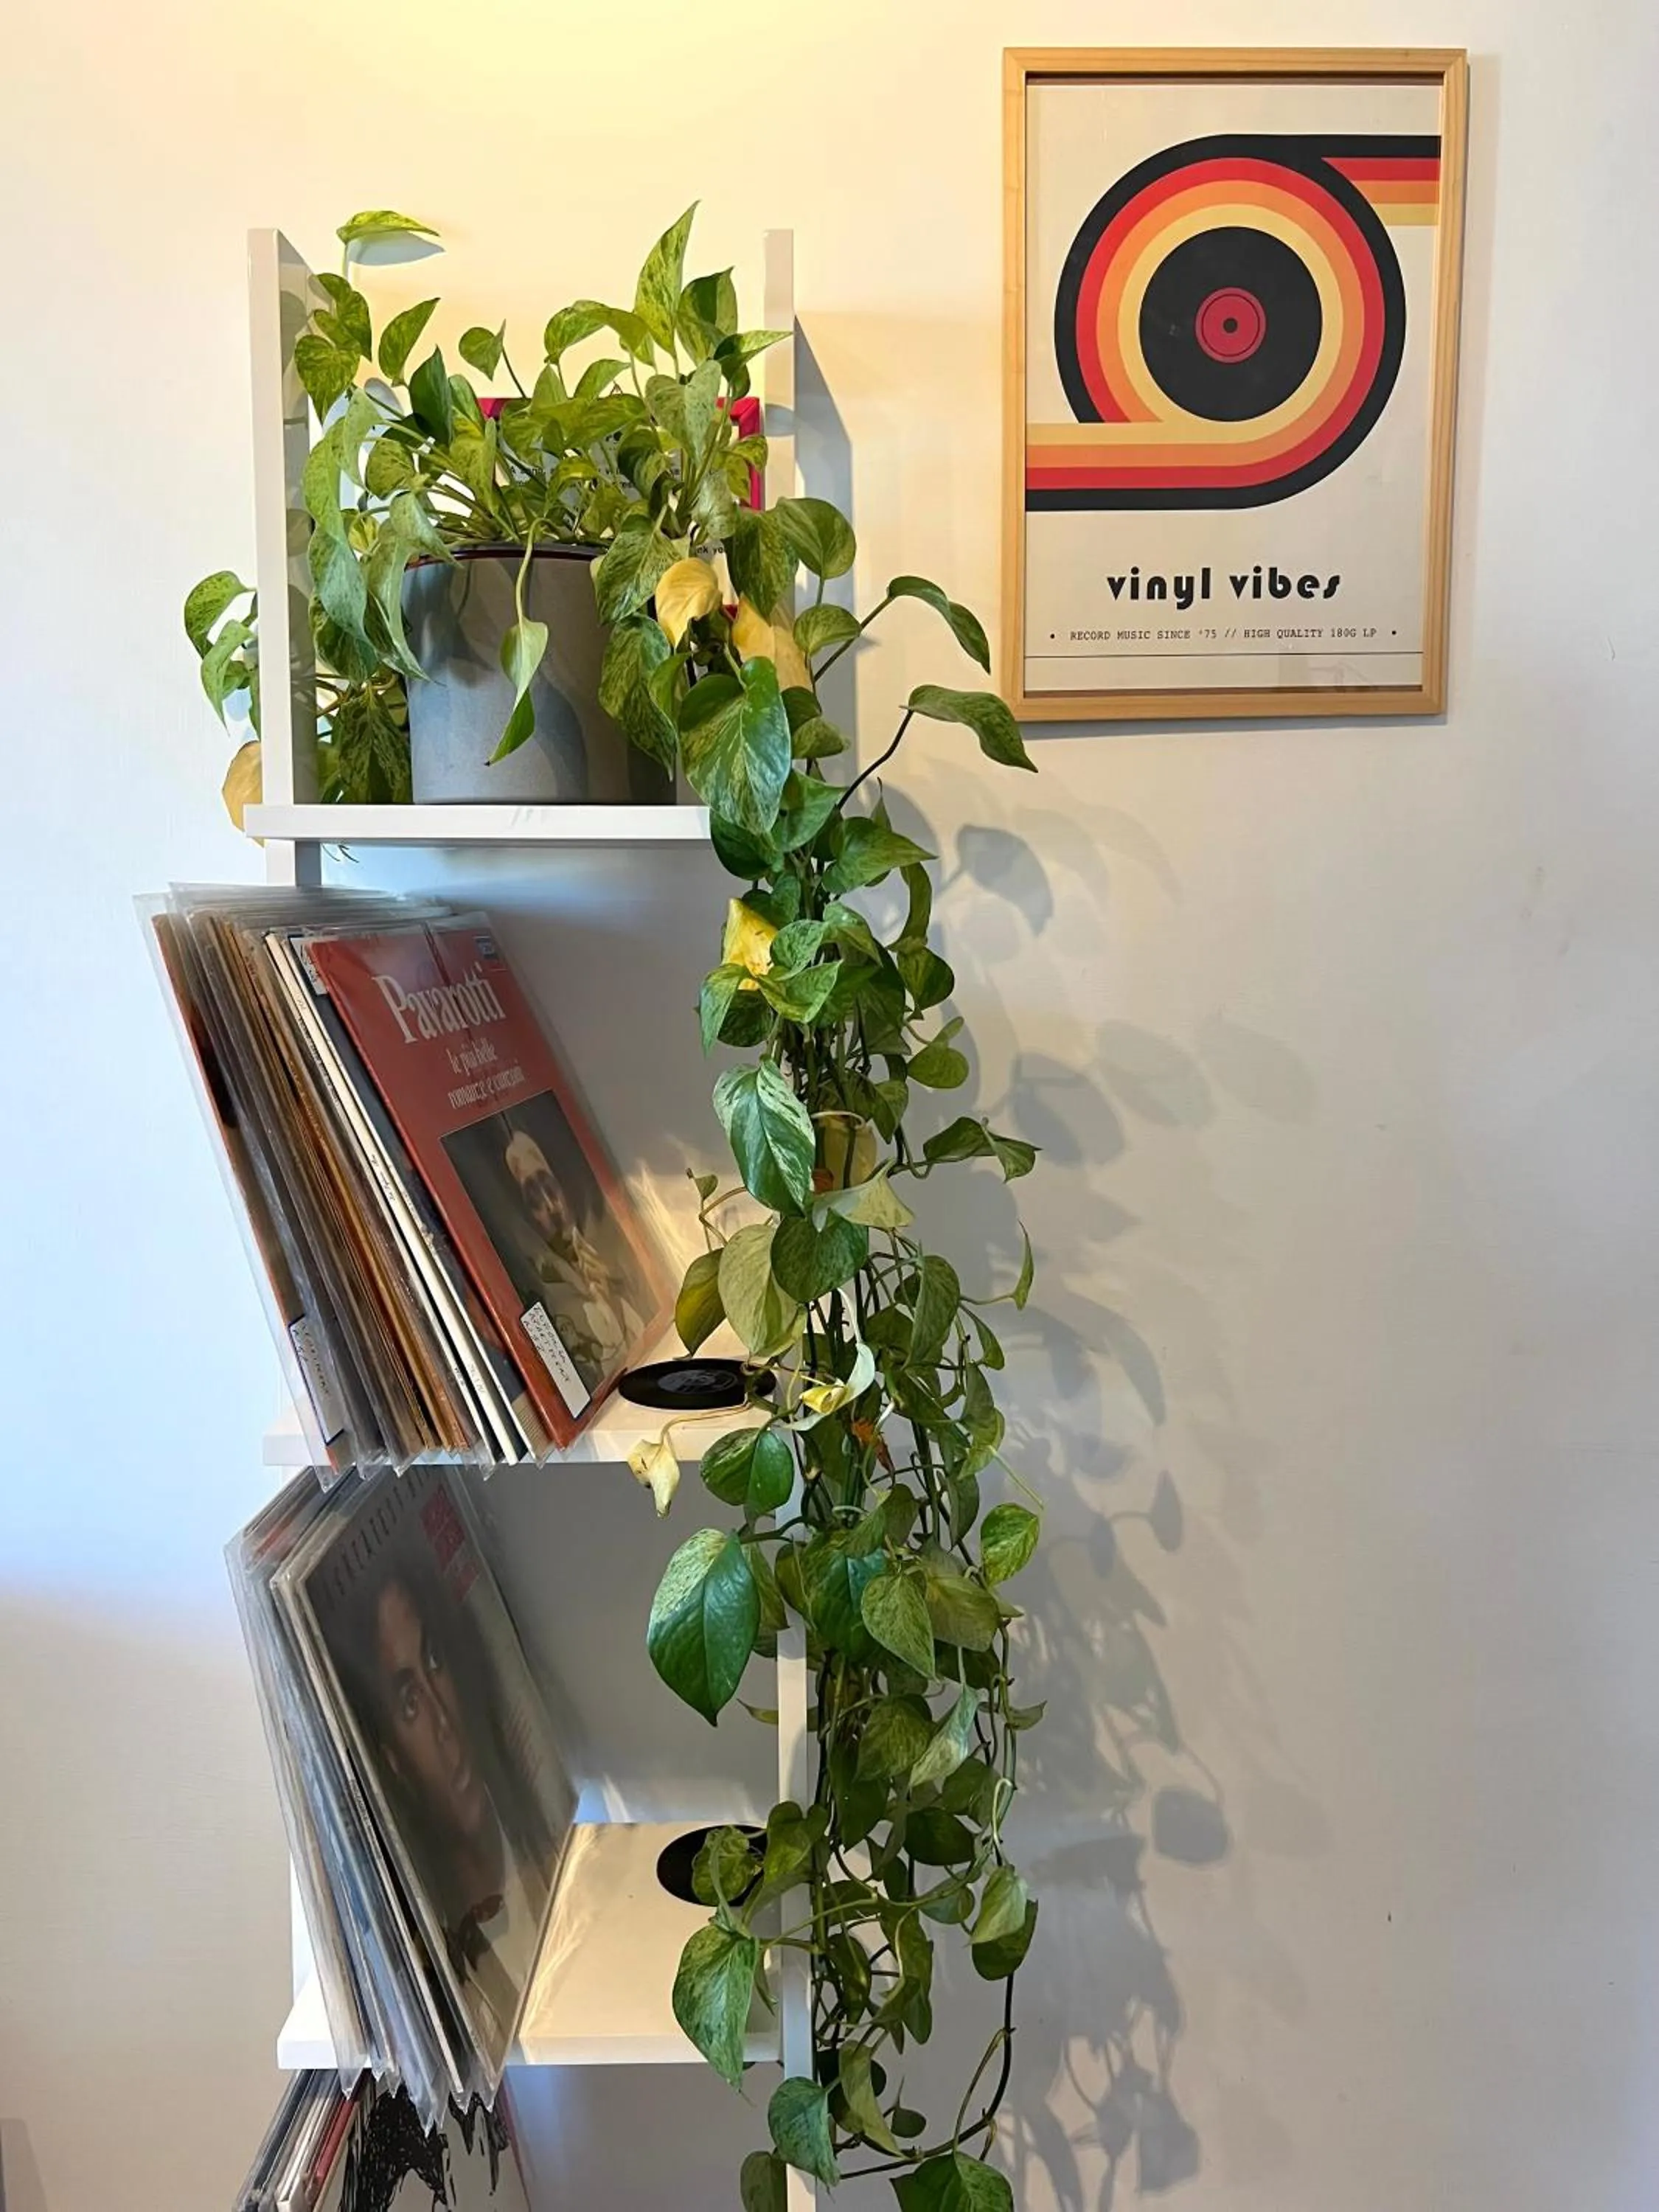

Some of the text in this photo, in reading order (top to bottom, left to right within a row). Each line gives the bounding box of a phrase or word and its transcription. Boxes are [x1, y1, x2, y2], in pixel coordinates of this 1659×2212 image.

[1107, 565, 1340, 611] vinyl vibes
[1070, 630, 1111, 641] RECORD
[1116, 630, 1151, 640] MUSIC
[1157, 630, 1191, 640] SINCE
[1243, 628, 1270, 639] HIGH
[1276, 628, 1324, 639] QUALITY
[1331, 627, 1357, 638] 180G
[1363, 627, 1377, 638] LP
[371, 961, 507, 1044] Pavarotti
